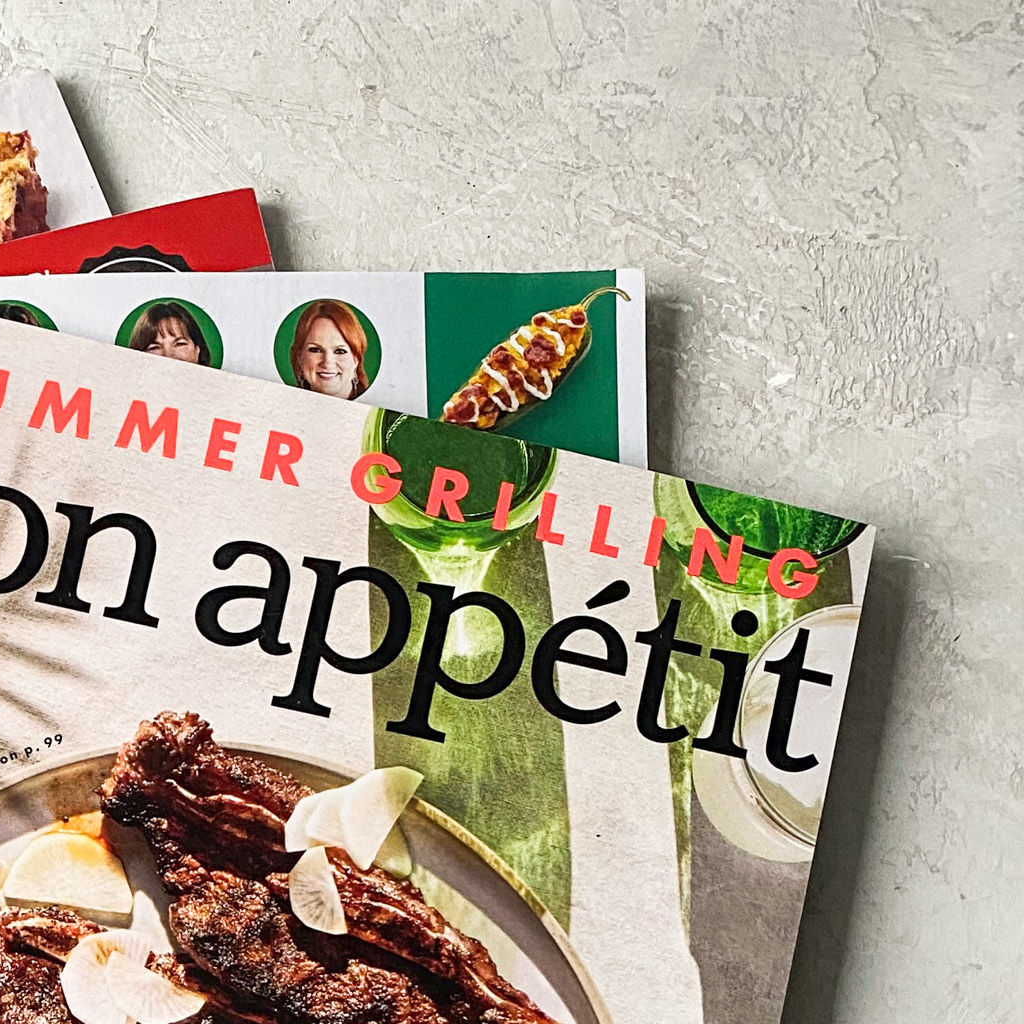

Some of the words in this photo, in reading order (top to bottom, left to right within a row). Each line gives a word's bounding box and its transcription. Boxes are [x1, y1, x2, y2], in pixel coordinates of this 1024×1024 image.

[350, 451, 820, 600] GRILLING
[194, 540, 834, 773] appétit
[24, 745, 40, 759] p.
[43, 733, 64, 749] 99
